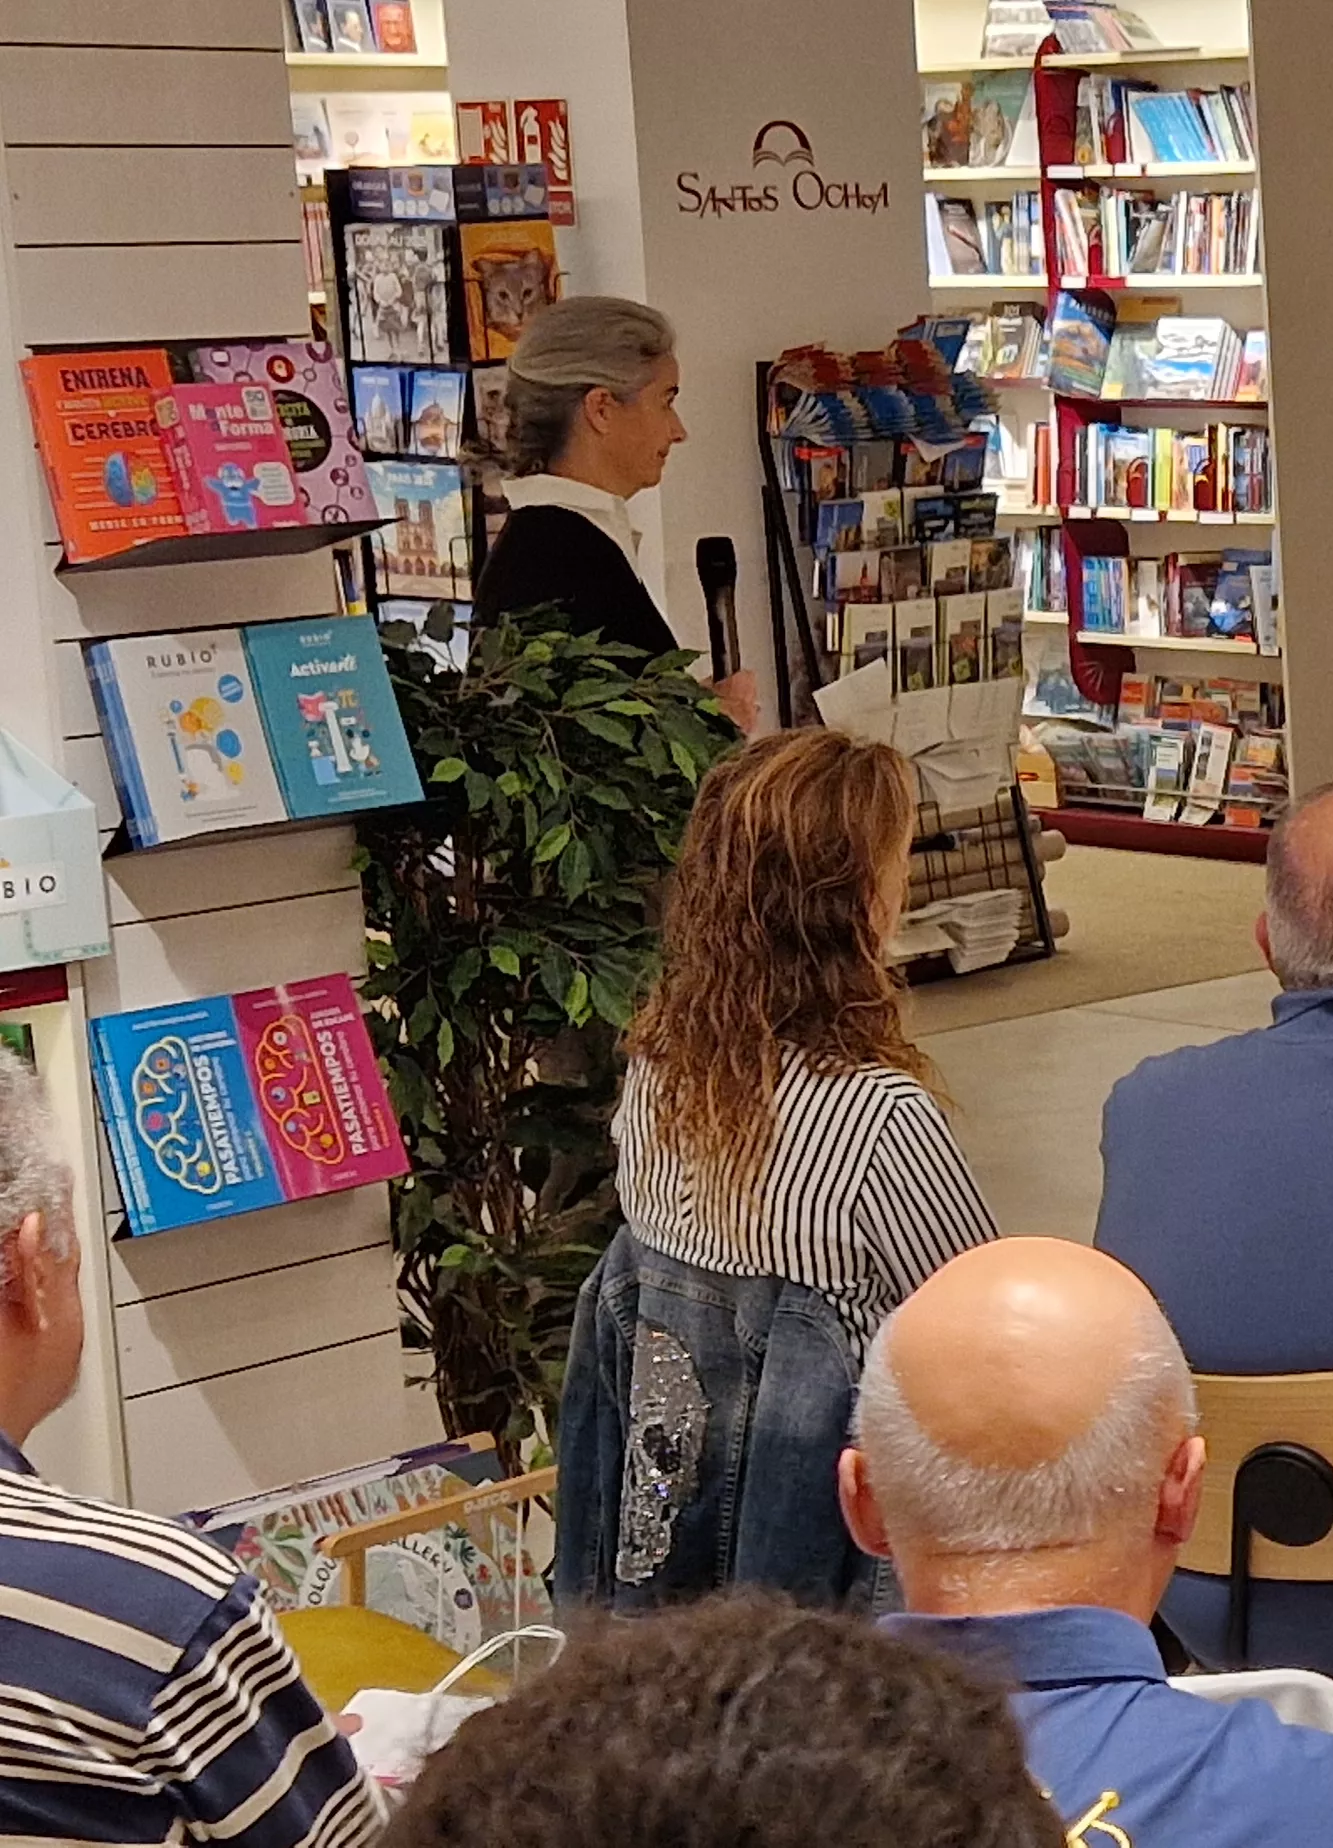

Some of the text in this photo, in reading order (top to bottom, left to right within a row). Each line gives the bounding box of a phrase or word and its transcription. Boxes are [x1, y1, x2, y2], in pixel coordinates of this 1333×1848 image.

[676, 170, 890, 219] SANTOS OCHOA
[60, 366, 152, 393] ENTRENA
[146, 650, 212, 670] RUBIO
[316, 1030, 368, 1156] PASATIEMPOS
[193, 1054, 244, 1186] PASATIEMPOS
[392, 1536, 454, 1574] LLERY
[308, 1559, 338, 1606] OLOU
